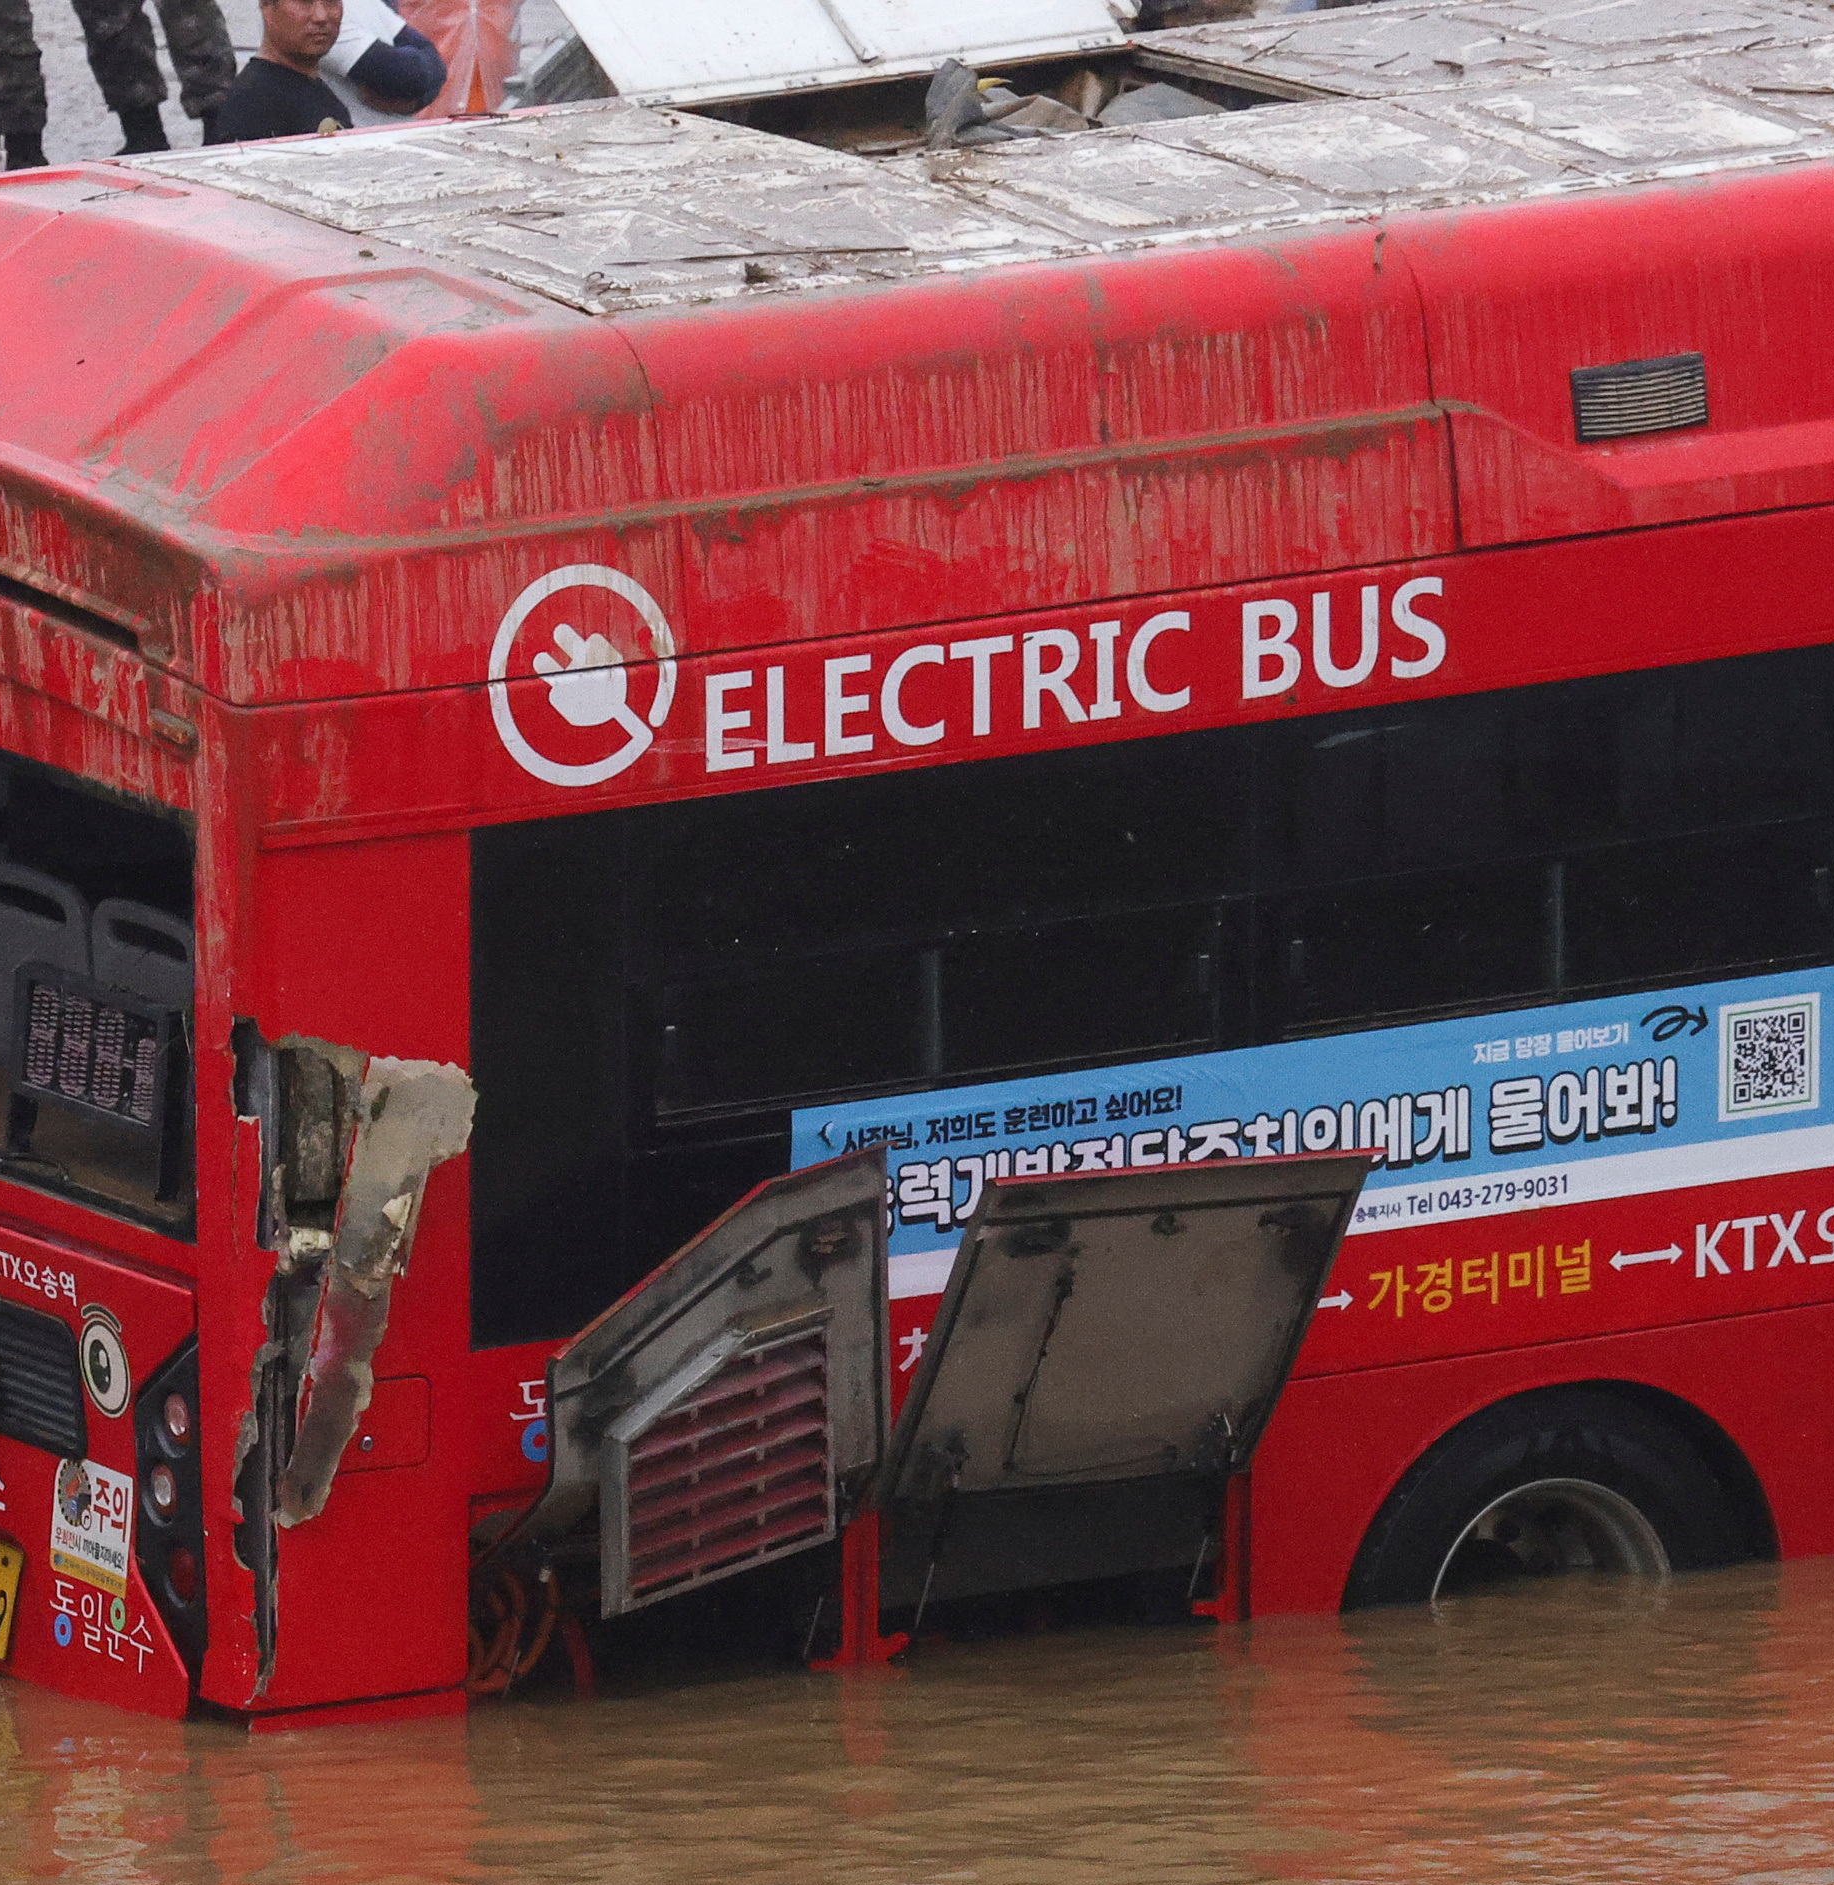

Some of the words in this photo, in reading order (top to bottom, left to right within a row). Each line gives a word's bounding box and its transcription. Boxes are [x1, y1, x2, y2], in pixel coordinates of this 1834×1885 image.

[704, 609, 1191, 773] ELECTRIC
[1241, 576, 1446, 700] BUS
[1472, 1041, 1511, 1064] 지금
[1556, 1022, 1630, 1054] 물어보기
[926, 1111, 997, 1145] 저희도
[1004, 1096, 1098, 1134] 훈련하고
[1105, 1085, 1183, 1122] 싶어요!
[1490, 1056, 1678, 1155] 물어봐!
[1407, 1192, 1433, 1216] Tel
[1438, 1174, 1569, 1212] 043-279-9031
[1366, 1238, 1593, 1319] 가경터미널
[93, 1476, 129, 1543] 주의
[49, 1579, 155, 1674] 동일운수
